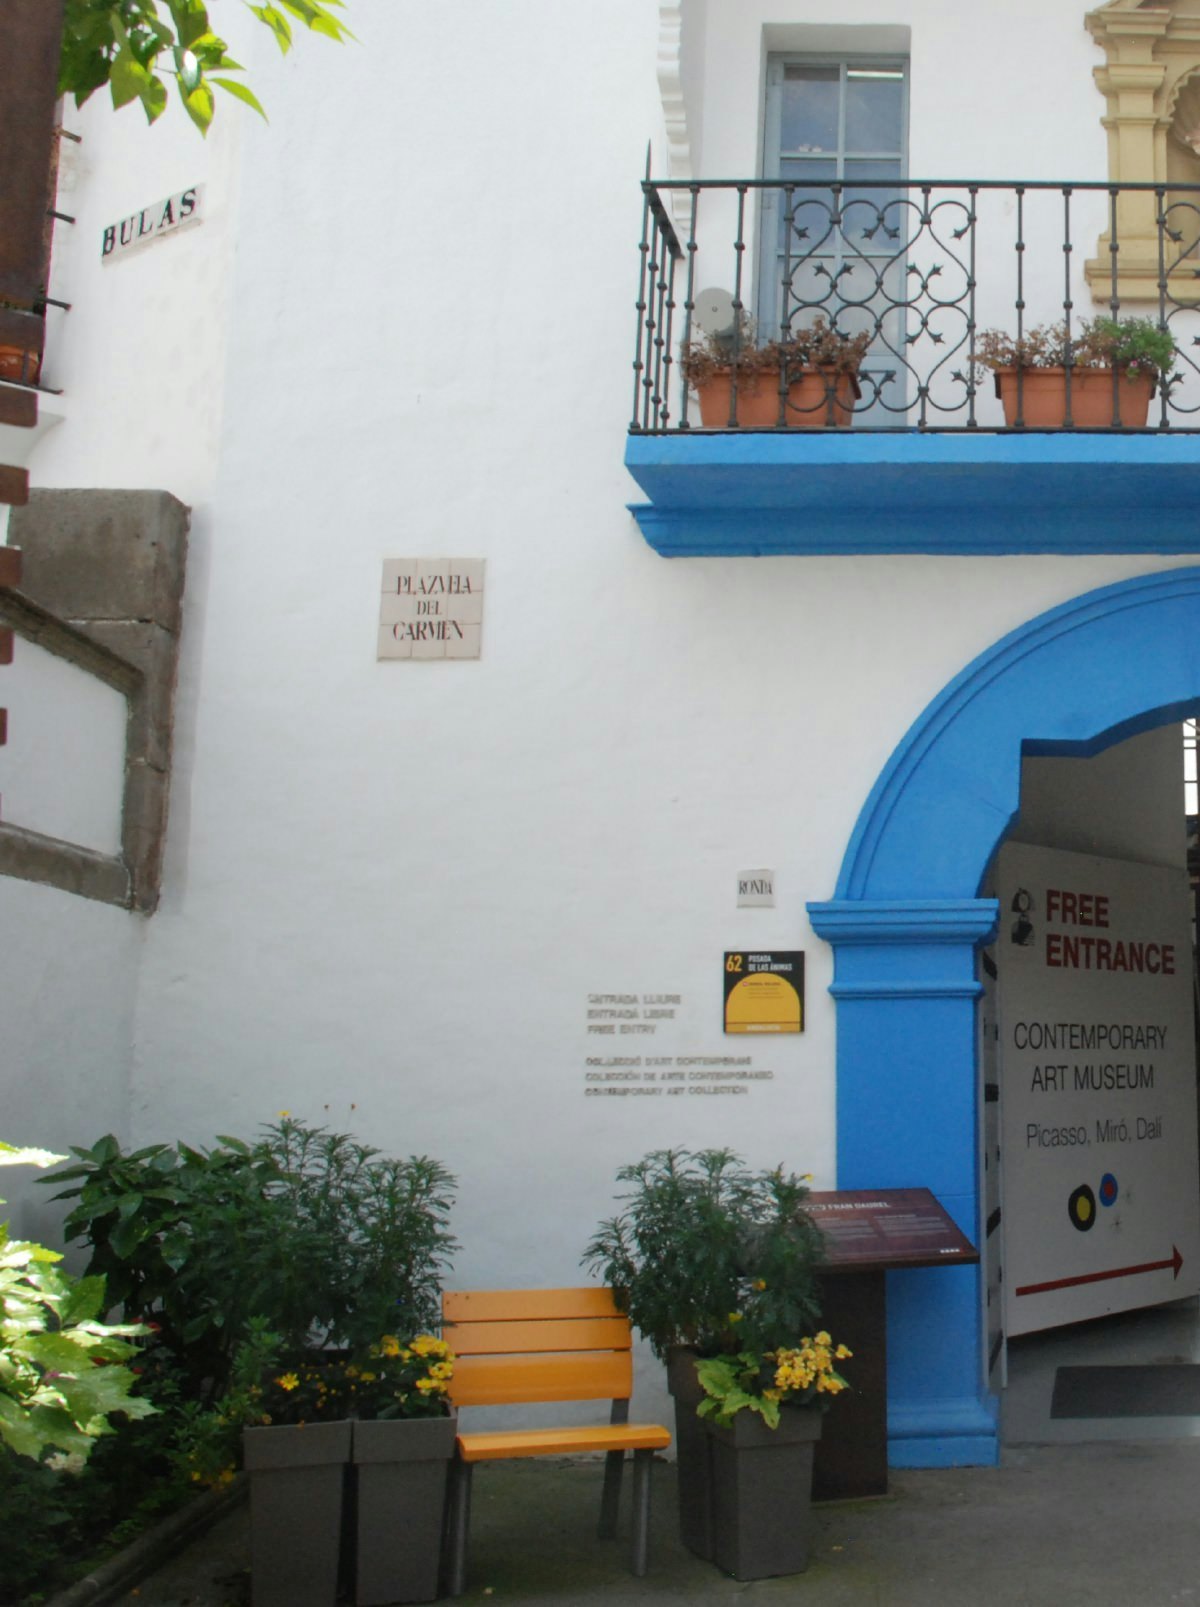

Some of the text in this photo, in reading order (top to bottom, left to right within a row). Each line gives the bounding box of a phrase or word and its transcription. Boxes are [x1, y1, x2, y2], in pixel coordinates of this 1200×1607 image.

[101, 187, 197, 257] BULAS
[416, 600, 442, 615] DEL
[392, 620, 464, 641] CARMEN
[1046, 889, 1109, 928] FREE
[726, 954, 742, 972] 62
[1046, 933, 1175, 975] ENTRANCE
[1014, 1022, 1167, 1050] CONTEMPORARY
[1031, 1064, 1154, 1092] ART MUSEUM
[1026, 1123, 1092, 1148] Picasso,
